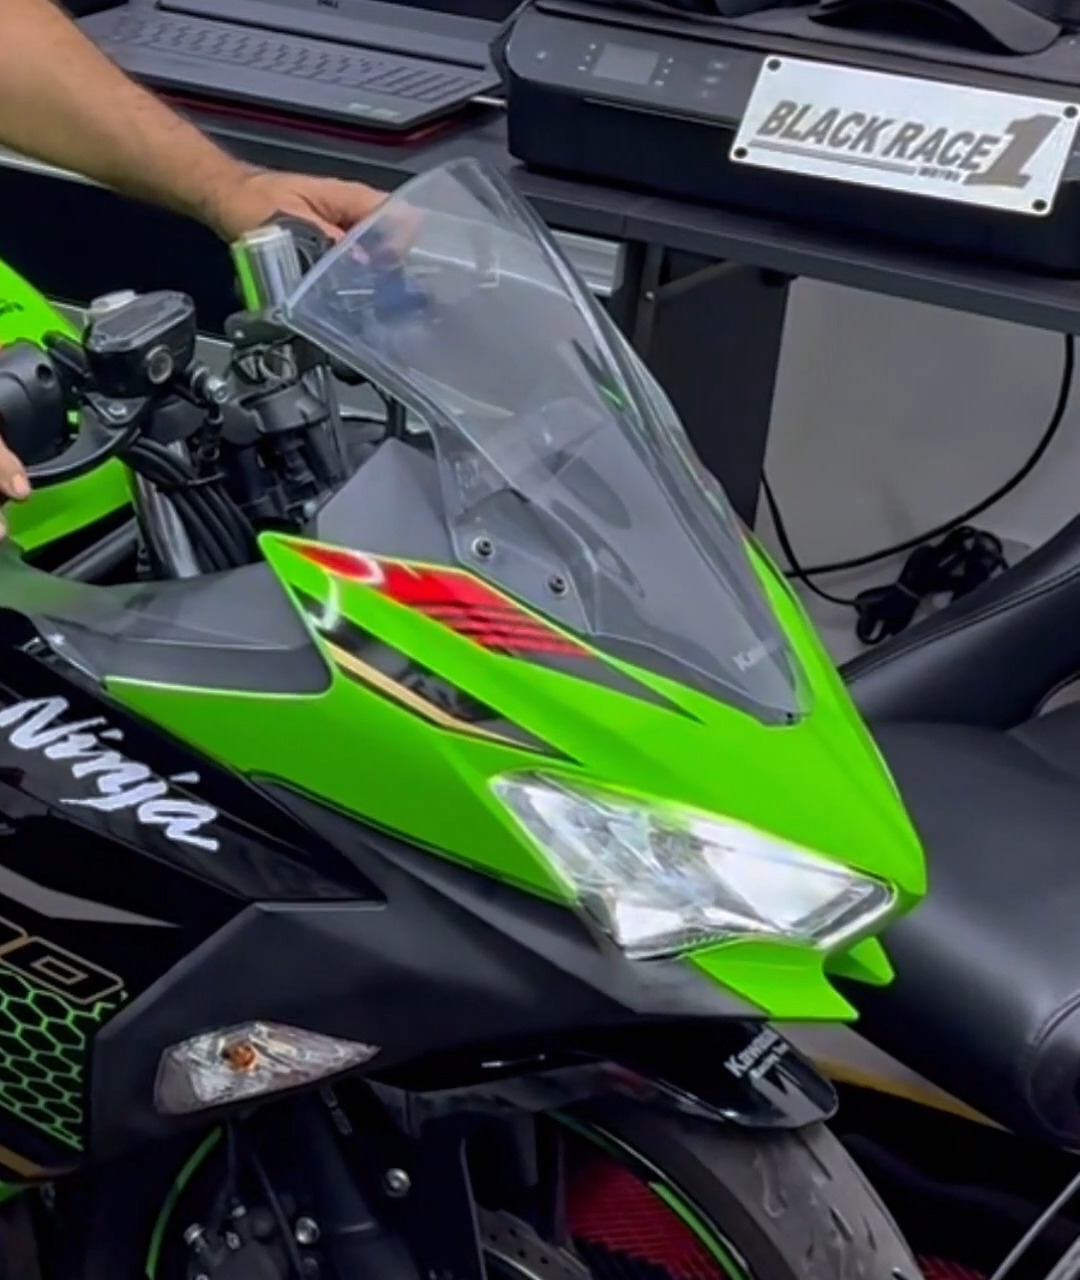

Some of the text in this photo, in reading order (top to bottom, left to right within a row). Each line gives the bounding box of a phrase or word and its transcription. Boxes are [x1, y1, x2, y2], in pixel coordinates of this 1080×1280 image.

[756, 99, 1063, 189] BLACK RACE 1
